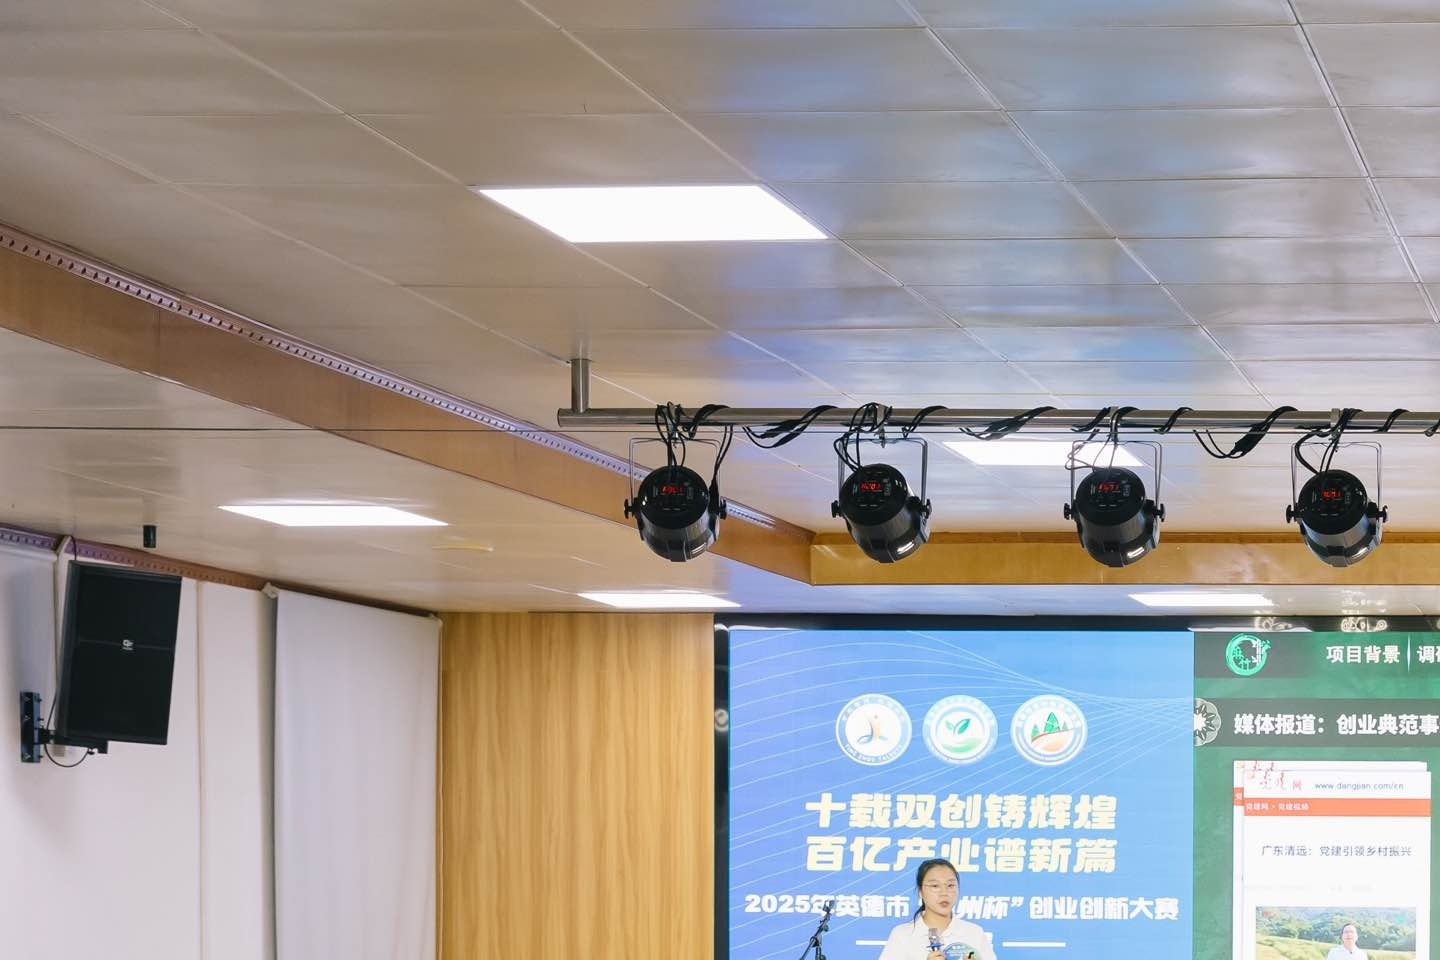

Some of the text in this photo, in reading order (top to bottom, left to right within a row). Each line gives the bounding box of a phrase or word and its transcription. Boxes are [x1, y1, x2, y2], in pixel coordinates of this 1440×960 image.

[1326, 645, 1401, 665] 项目背景
[804, 792, 1118, 830] 十载双创铸辉煌
[805, 836, 1118, 873] 百亿产业谱新篇
[744, 893, 1182, 921] 2025年英德市“州杯”创业创新大赛
